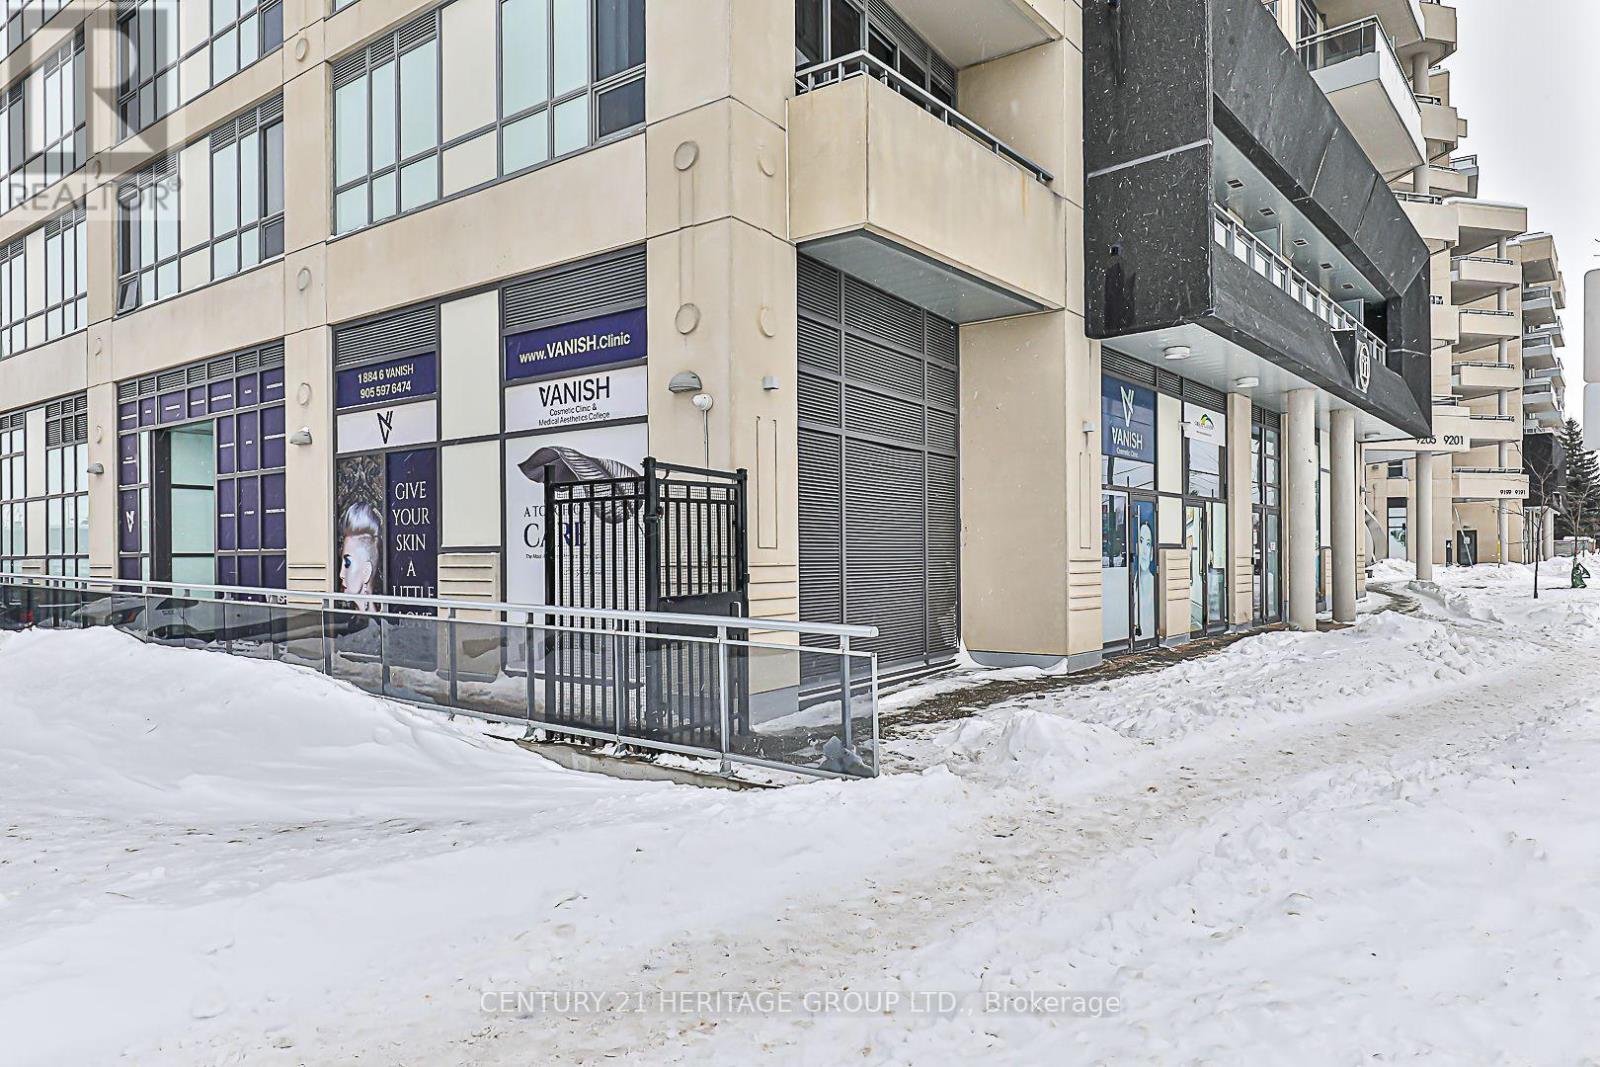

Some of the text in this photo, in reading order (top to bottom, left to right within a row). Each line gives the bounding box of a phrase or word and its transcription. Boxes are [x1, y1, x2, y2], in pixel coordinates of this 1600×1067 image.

[385, 363, 414, 378] VANISH
[360, 381, 411, 398] 905 597 6474
[539, 376, 610, 407] VANISH
[1111, 426, 1143, 450] VANISH
[1443, 435, 1464, 446] 9201
[395, 481, 427, 500] GIVE
[392, 507, 431, 526] YOUR
[523, 506, 531, 518] A
[396, 534, 426, 551] SKIN
[406, 560, 416, 577] A
